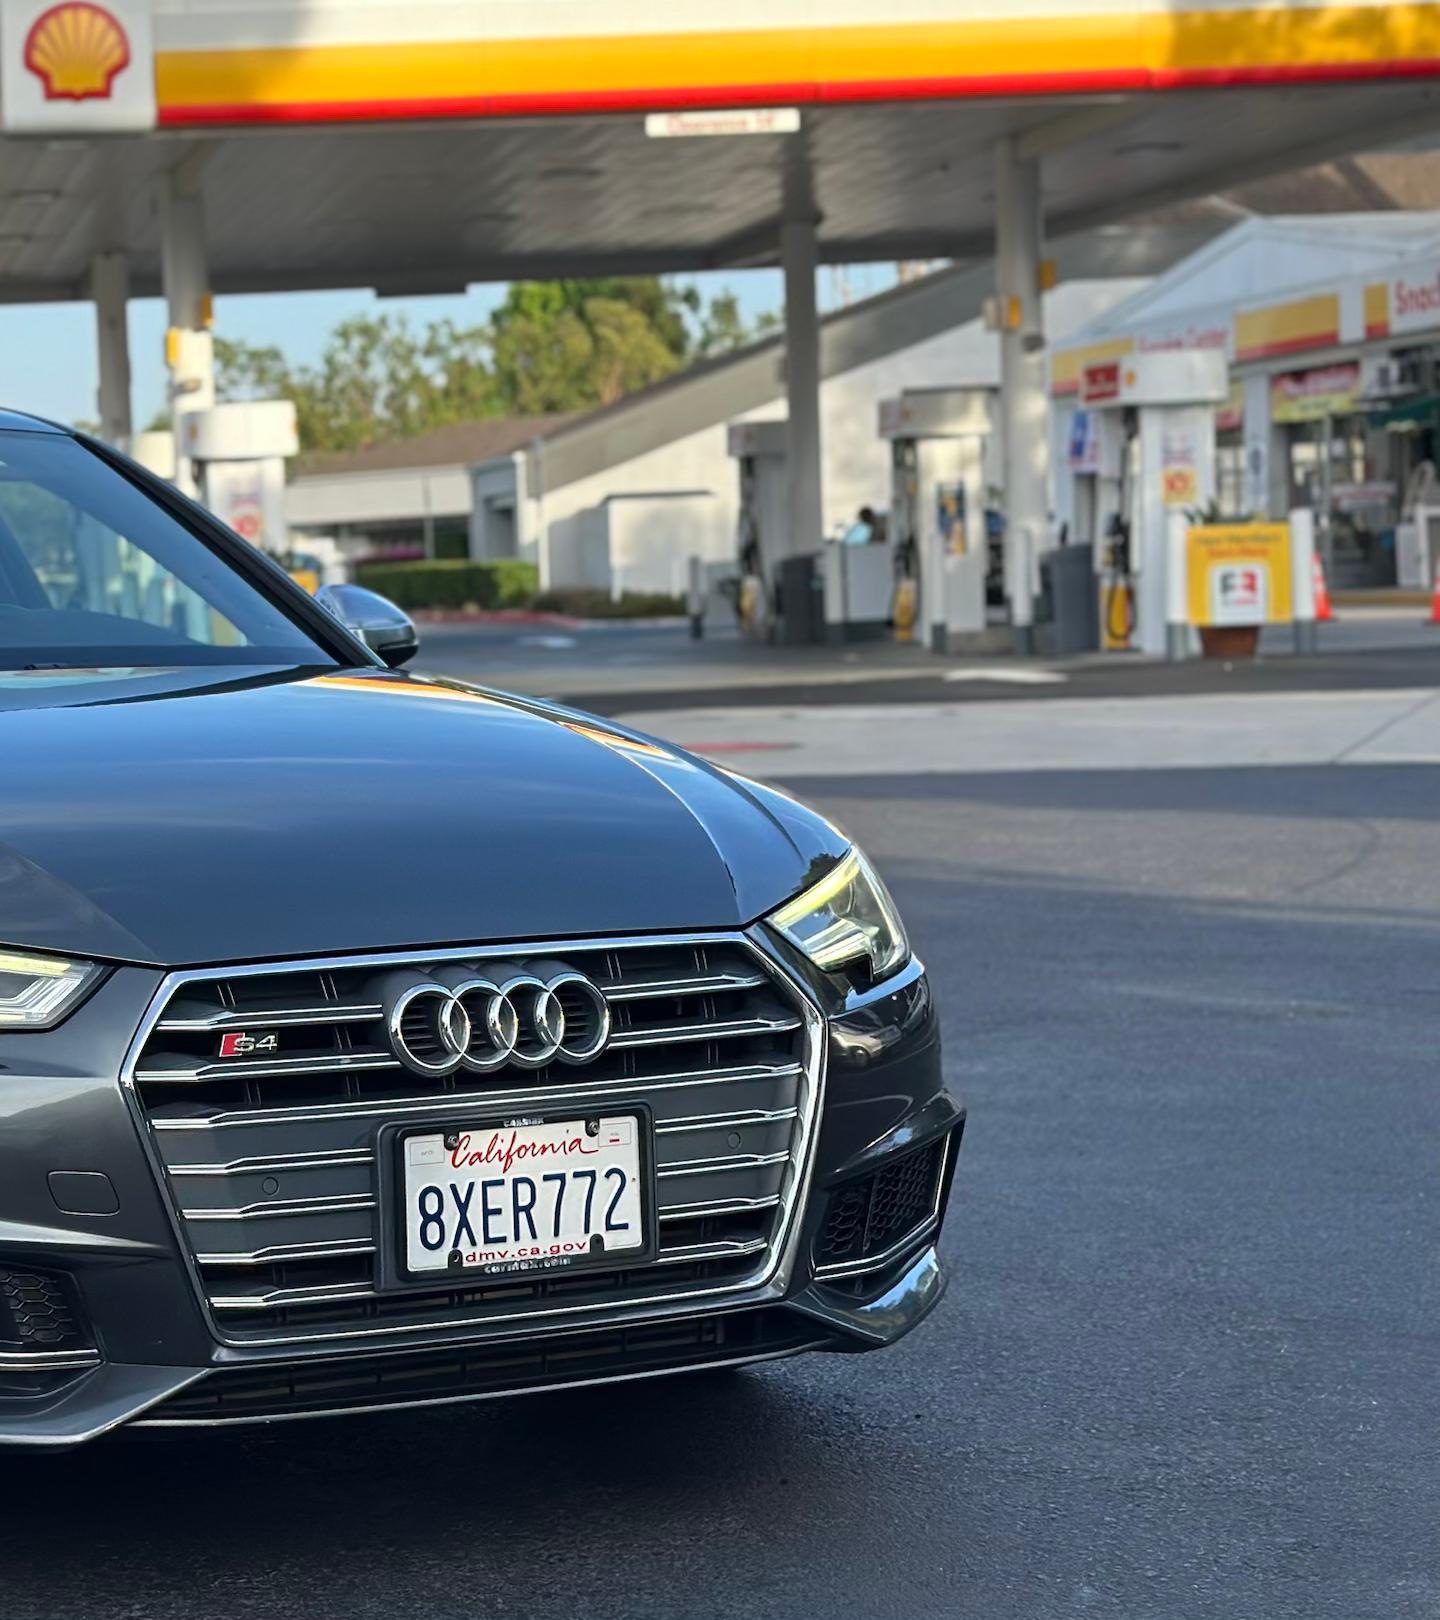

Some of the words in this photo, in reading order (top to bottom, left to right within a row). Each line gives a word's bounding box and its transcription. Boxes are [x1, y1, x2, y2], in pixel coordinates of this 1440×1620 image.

[233, 1034, 278, 1054] S4
[451, 1130, 599, 1174] California
[418, 1167, 630, 1251] 8XER772
[465, 1240, 588, 1263] dmv.ca.gov
